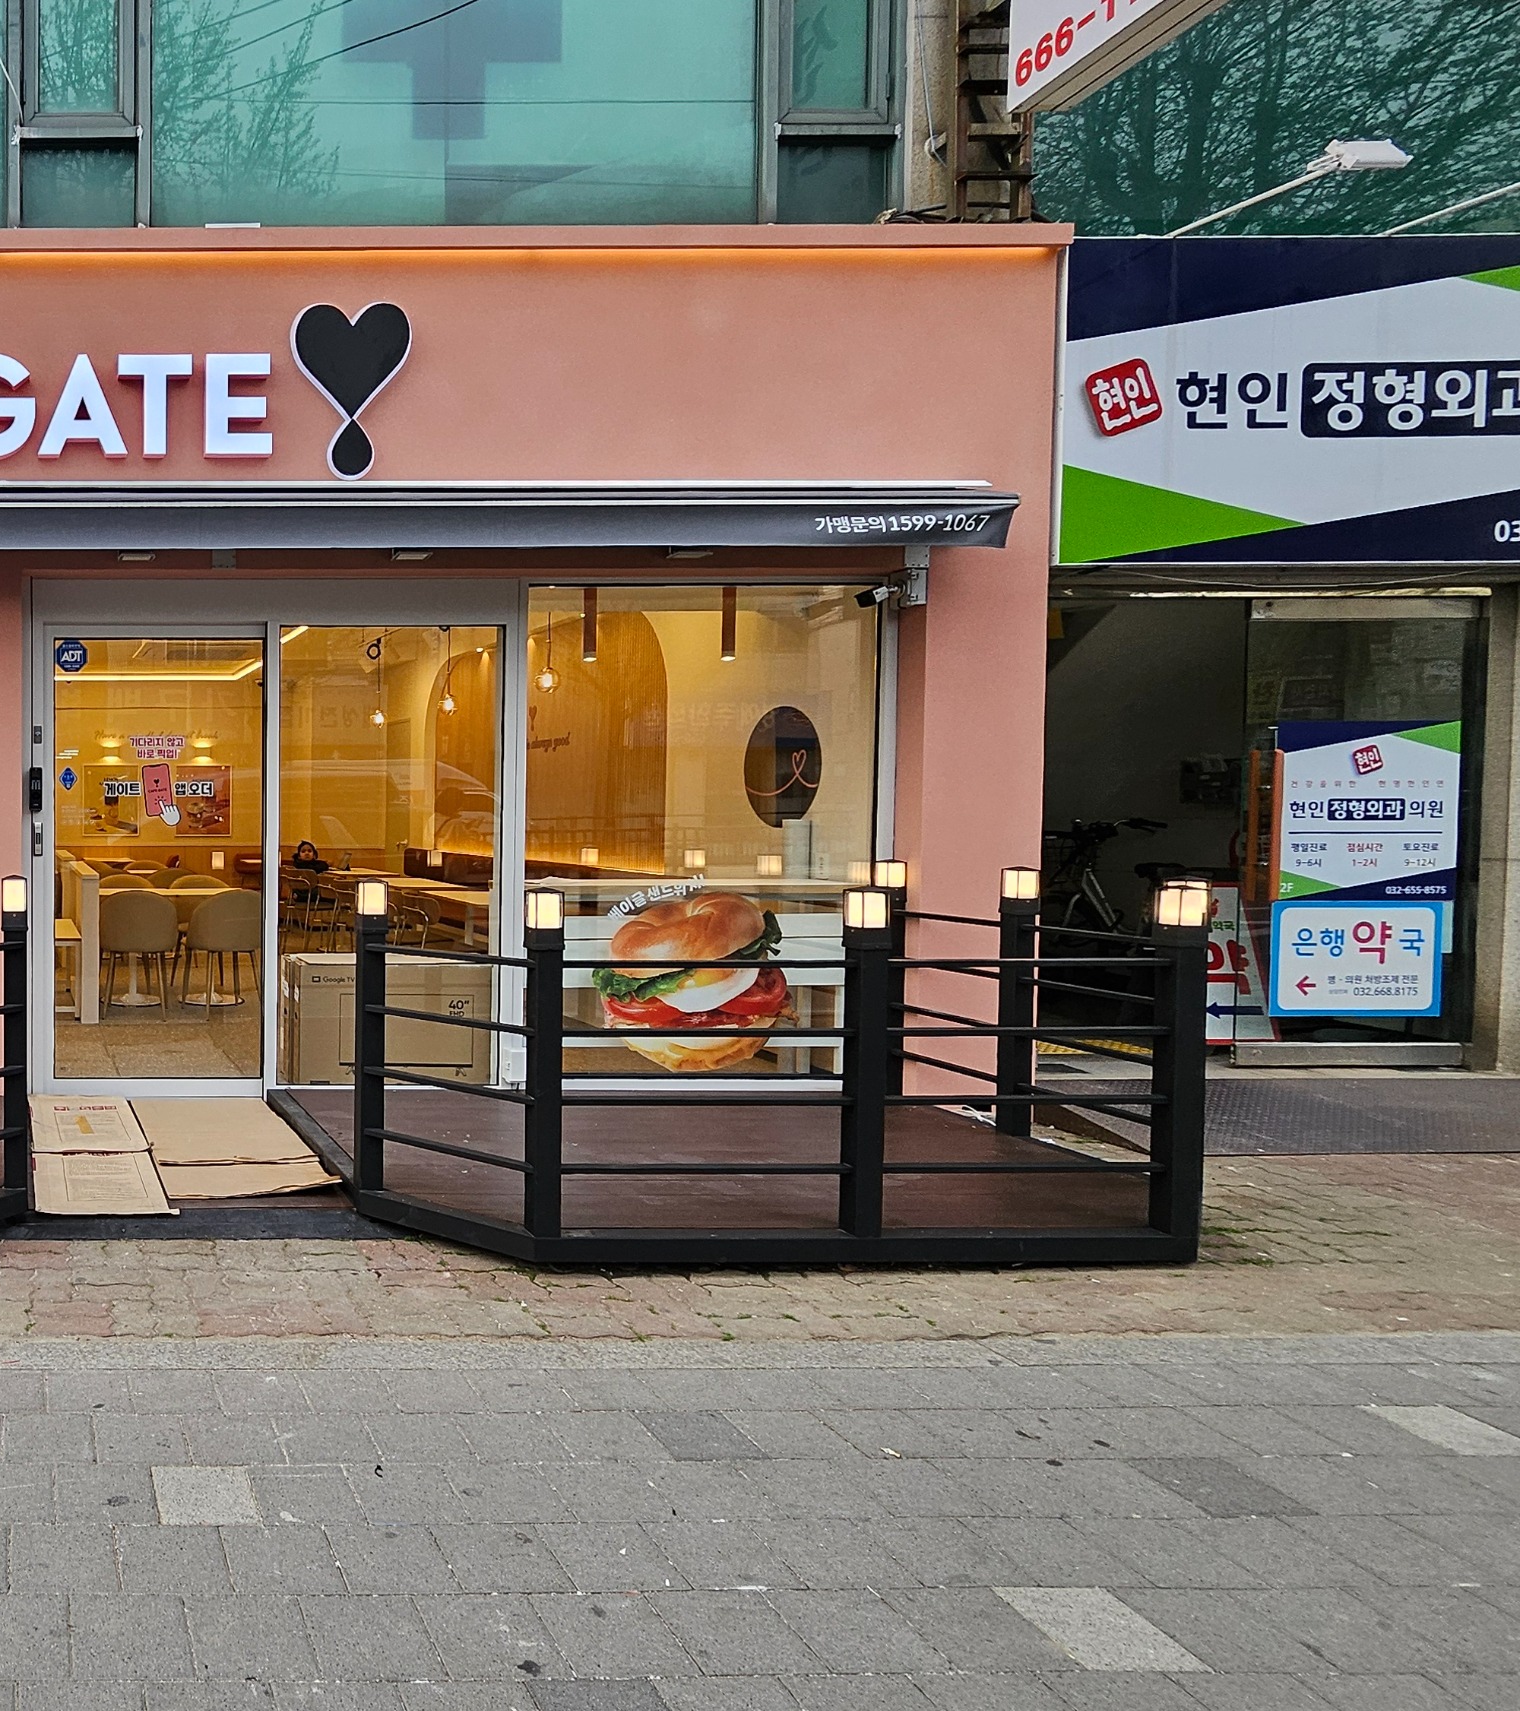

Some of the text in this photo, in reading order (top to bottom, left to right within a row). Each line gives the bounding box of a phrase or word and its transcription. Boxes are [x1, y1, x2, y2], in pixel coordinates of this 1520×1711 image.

[1091, 366, 1159, 431] 현인
[1176, 371, 1289, 429] 현인
[815, 514, 990, 533] 가맹문의 1599-1067
[61, 650, 83, 662] ADT
[130, 737, 185, 747] 기다리지 않고
[137, 749, 155, 759] 바로
[1355, 748, 1383, 774] 현인
[105, 783, 213, 796] 게이트 앱 오더
[1289, 800, 1445, 819] 현인 정형외과 의원
[1291, 842, 1328, 853] 평일진료
[1402, 842, 1440, 852] 토요진료
[1385, 885, 1448, 895] 032-655-8575
[323, 976, 346, 984] Google
[1353, 987, 1418, 997] 032.668.8175
